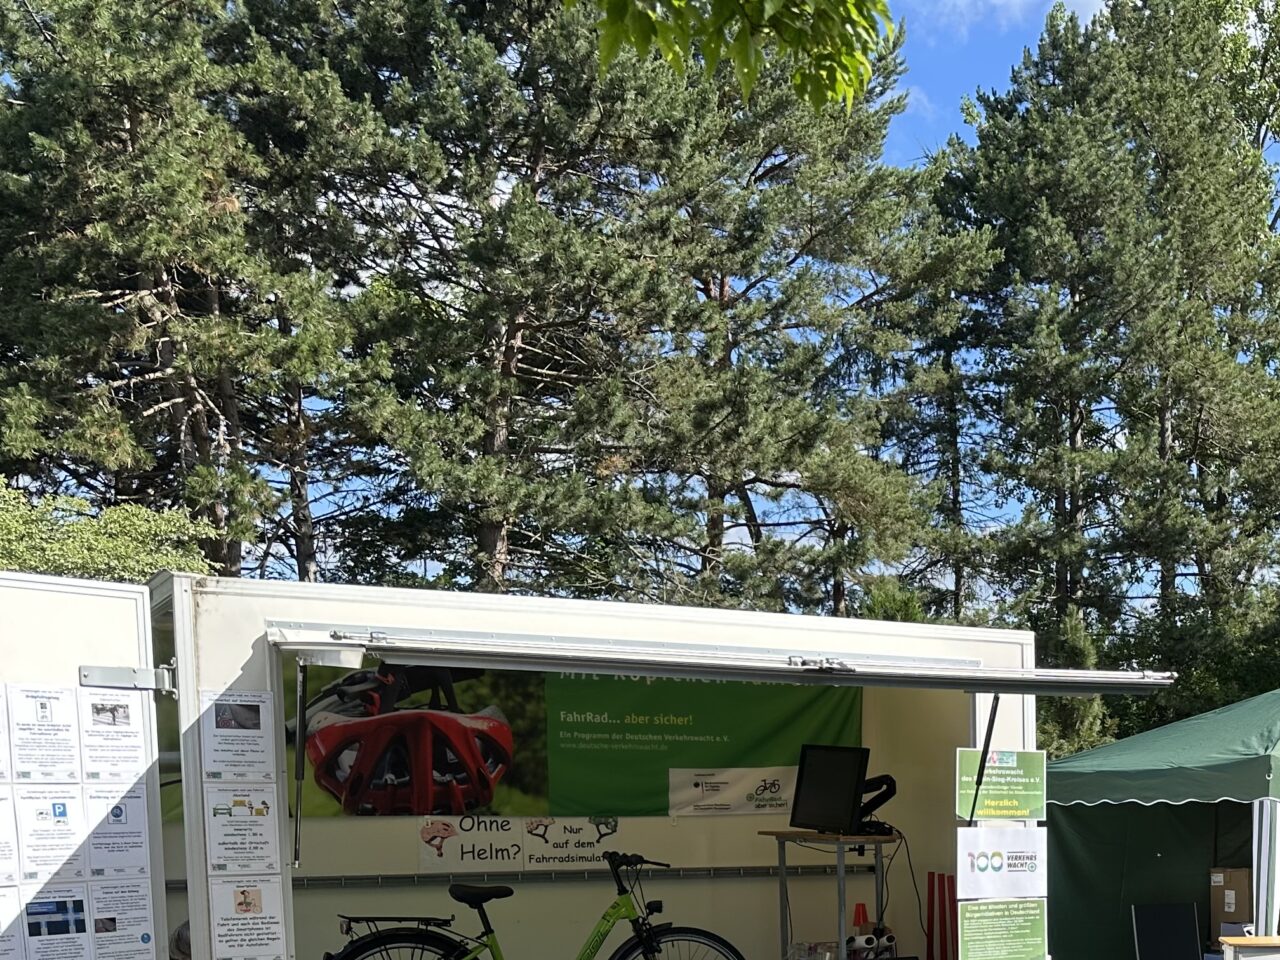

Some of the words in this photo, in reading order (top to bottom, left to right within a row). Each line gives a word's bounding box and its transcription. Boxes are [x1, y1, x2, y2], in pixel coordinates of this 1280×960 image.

[624, 713, 649, 724] aber
[654, 713, 692, 726] sicher!
[459, 815, 512, 832] Ohne
[564, 825, 584, 834] Nur
[460, 843, 521, 861] Helm?
[553, 840, 569, 849] auf
[575, 840, 595, 848] dem
[968, 851, 1004, 872] 100
